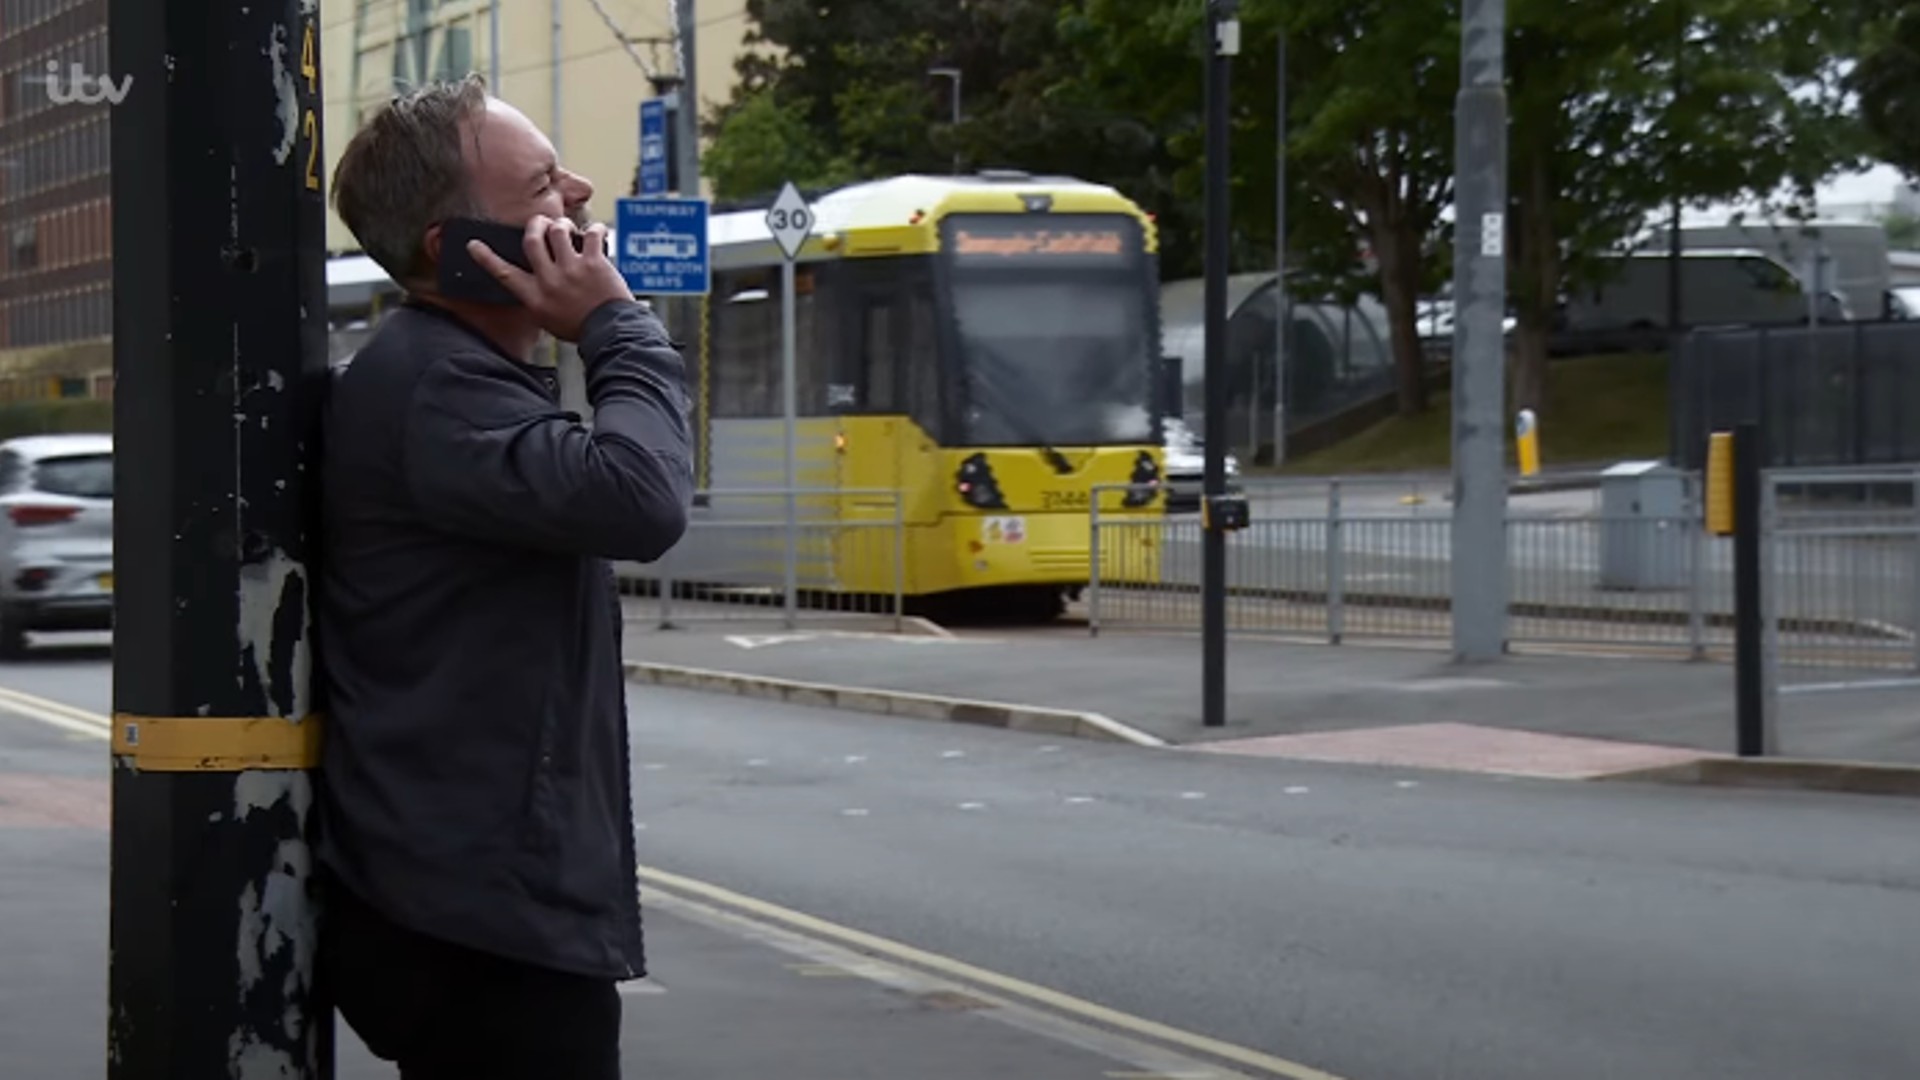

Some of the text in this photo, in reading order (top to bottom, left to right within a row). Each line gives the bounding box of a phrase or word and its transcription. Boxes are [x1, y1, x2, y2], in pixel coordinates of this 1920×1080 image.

[626, 203, 697, 217] TRAMWAY
[773, 209, 807, 230] 30
[622, 261, 703, 273] LOOK BOTH
[643, 276, 683, 288] WAYS
